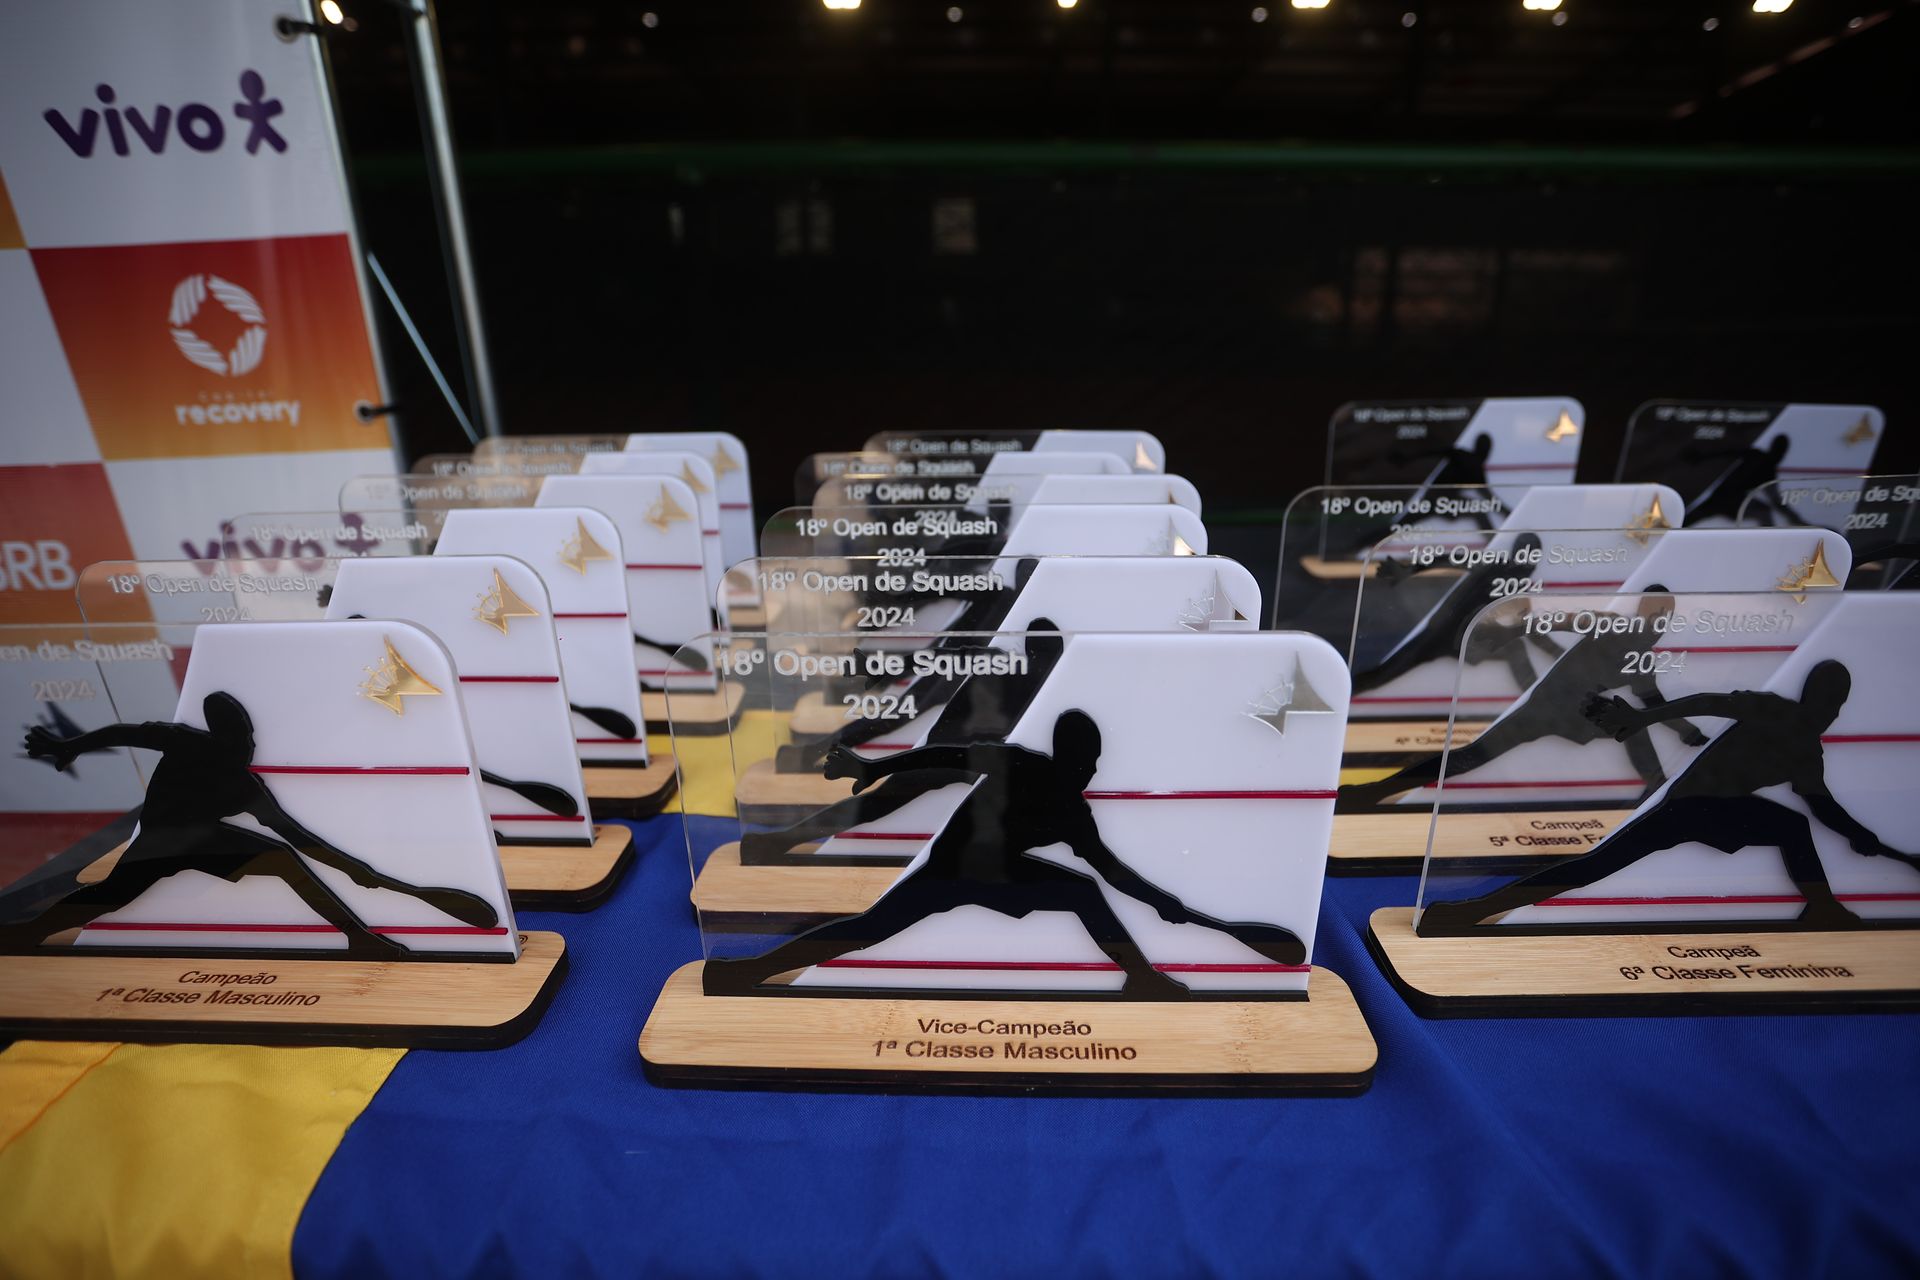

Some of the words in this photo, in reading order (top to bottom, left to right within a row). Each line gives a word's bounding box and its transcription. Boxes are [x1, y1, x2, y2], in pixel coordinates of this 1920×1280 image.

[43, 83, 226, 159] vivo
[174, 400, 300, 427] recovery
[910, 439, 948, 453] Open
[953, 438, 969, 451] de
[970, 438, 1022, 453] Squash
[895, 460, 915, 474] de
[917, 460, 976, 475] Squash
[846, 484, 873, 500] 18º
[876, 483, 924, 503] Open
[928, 482, 951, 499] de
[1780, 490, 1809, 505] 18º
[1813, 487, 1861, 506] Open
[1864, 485, 1889, 502] de
[1321, 497, 1350, 515] 18º
[1354, 497, 1403, 517] Open
[1408, 497, 1431, 514] de
[1435, 496, 1501, 517] Squash
[796, 519, 827, 536] 18º
[833, 518, 887, 539] Open
[892, 517, 918, 535] de
[923, 517, 998, 539] Squash
[1844, 512, 1889, 530] 2024
[335, 524, 358, 539] de
[361, 520, 427, 545] Squash
[877, 547, 926, 567] 2024
[1409, 546, 1444, 566] 18º
[1450, 546, 1509, 566] Open
[1514, 545, 1543, 564] de
[1549, 546, 1629, 566] Squash
[106, 574, 140, 594] 18º
[145, 573, 202, 597] Open
[208, 573, 235, 592] de
[238, 574, 320, 597] Squash
[759, 572, 795, 592] 18º
[803, 572, 868, 593] Open
[875, 571, 906, 592] de
[912, 571, 1004, 595] Squash
[1489, 577, 1543, 598] 2024
[857, 607, 916, 628] 2024
[1522, 611, 1566, 634] 18º
[1573, 611, 1645, 638] Open
[1653, 611, 1688, 633] de
[1694, 609, 1793, 638] Squash
[37, 639, 69, 662] de
[73, 638, 175, 664] Squash
[719, 650, 764, 676] 18º
[774, 650, 856, 681] Open
[865, 650, 904, 676] de
[912, 651, 1028, 681] Squash
[1621, 651, 1687, 674] 2024
[31, 680, 96, 701] 2024
[842, 694, 918, 720] 2024
[1530, 819, 1604, 831] Campeã
[1489, 836, 1509, 846] 5ª
[1515, 835, 1582, 846] Classe
[1667, 945, 1761, 960] Campeã
[178, 970, 277, 986] Campeão
[1619, 966, 1645, 980] 6ª
[1651, 966, 1737, 980] Classe
[1737, 965, 1854, 978] Feminina
[96, 988, 125, 1000] 1ª
[123, 988, 201, 1003] Classe
[204, 990, 320, 1006] Masculino
[918, 1019, 1092, 1038] Vice-Campeão
[872, 1041, 897, 1057] 1ª
[905, 1041, 994, 1058] Classe
[1004, 1043, 1137, 1060] Masculino
